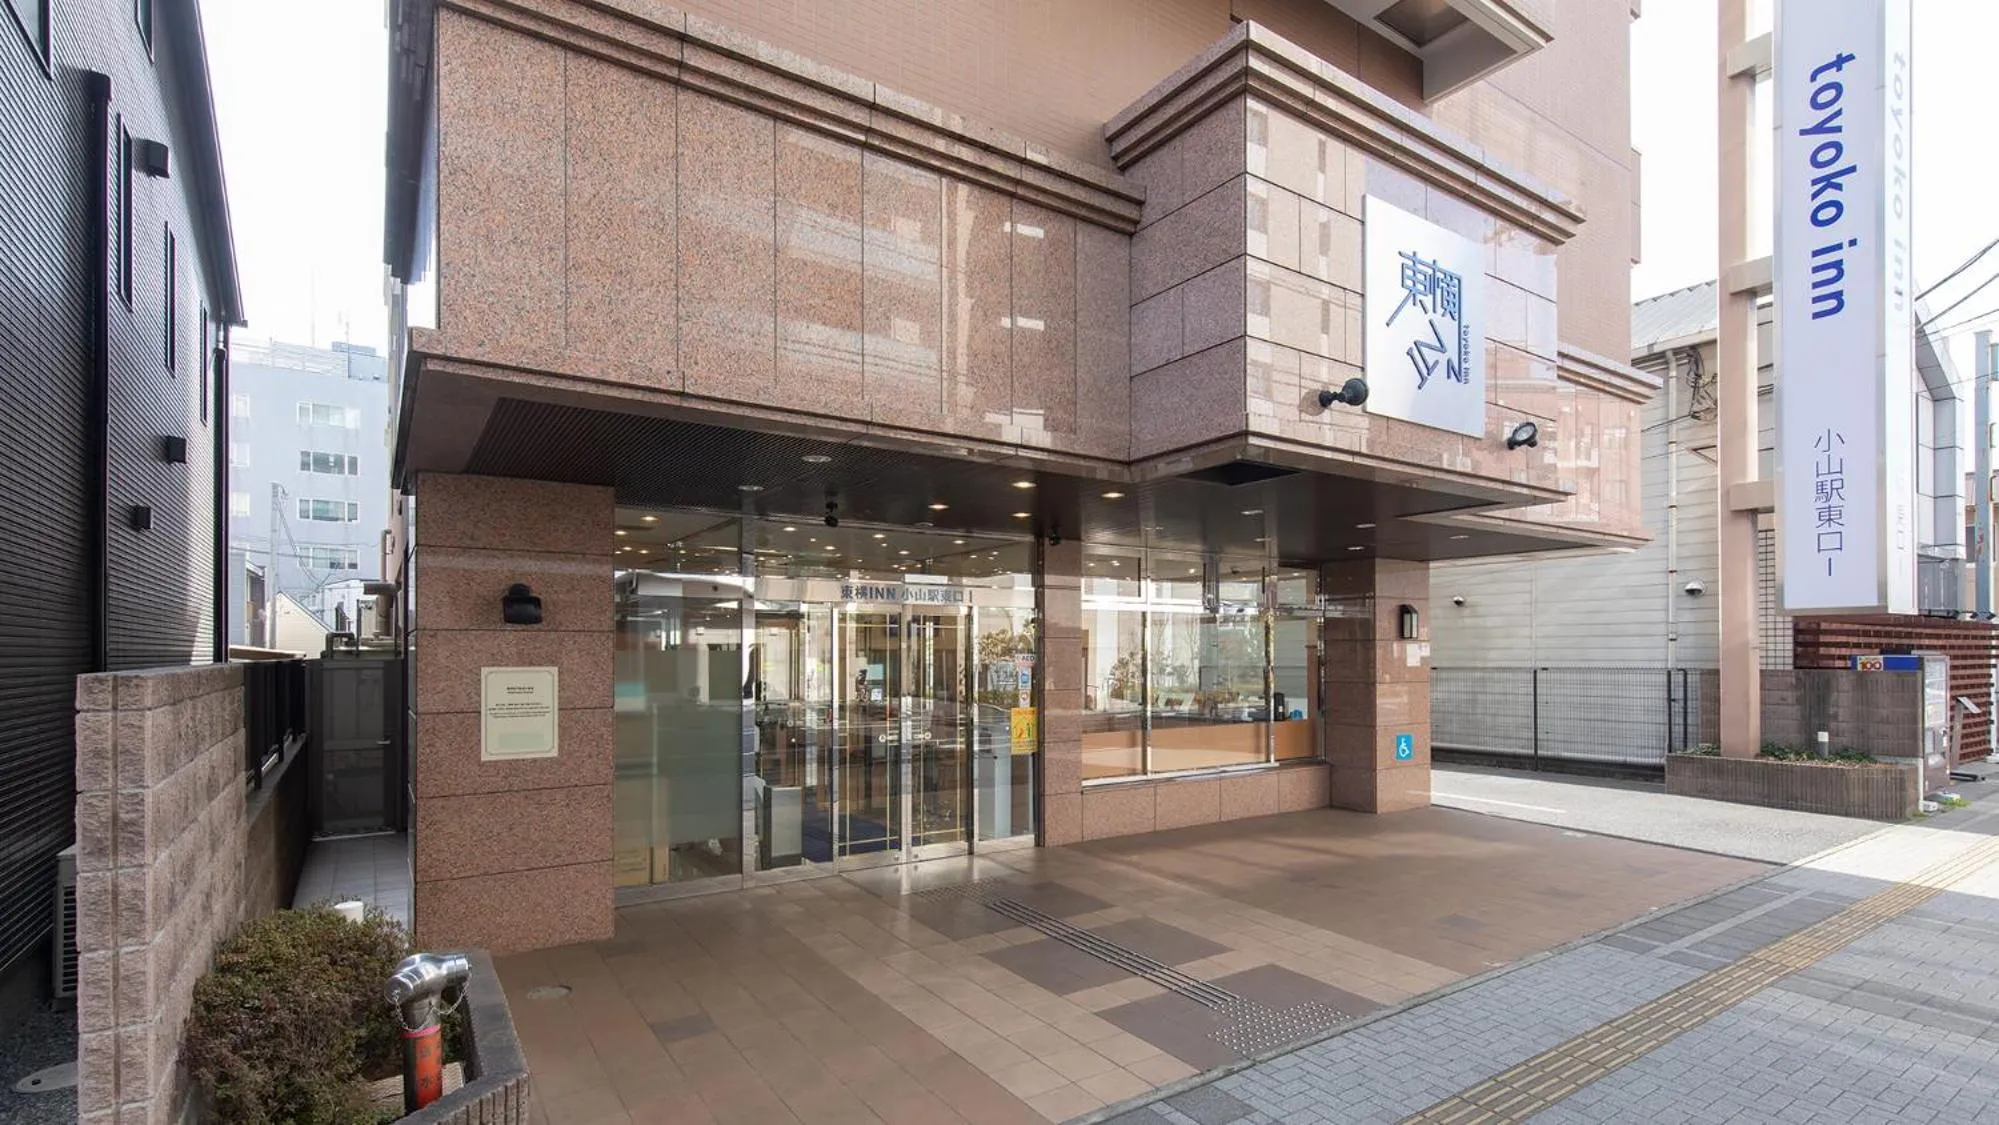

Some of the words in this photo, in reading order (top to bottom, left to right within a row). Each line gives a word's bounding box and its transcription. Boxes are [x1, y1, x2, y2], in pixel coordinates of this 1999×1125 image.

[1799, 52, 1857, 227] toyoko
[1811, 237, 1858, 320] inn
[841, 584, 897, 601] 東横INN
[1859, 660, 1882, 670] 100
